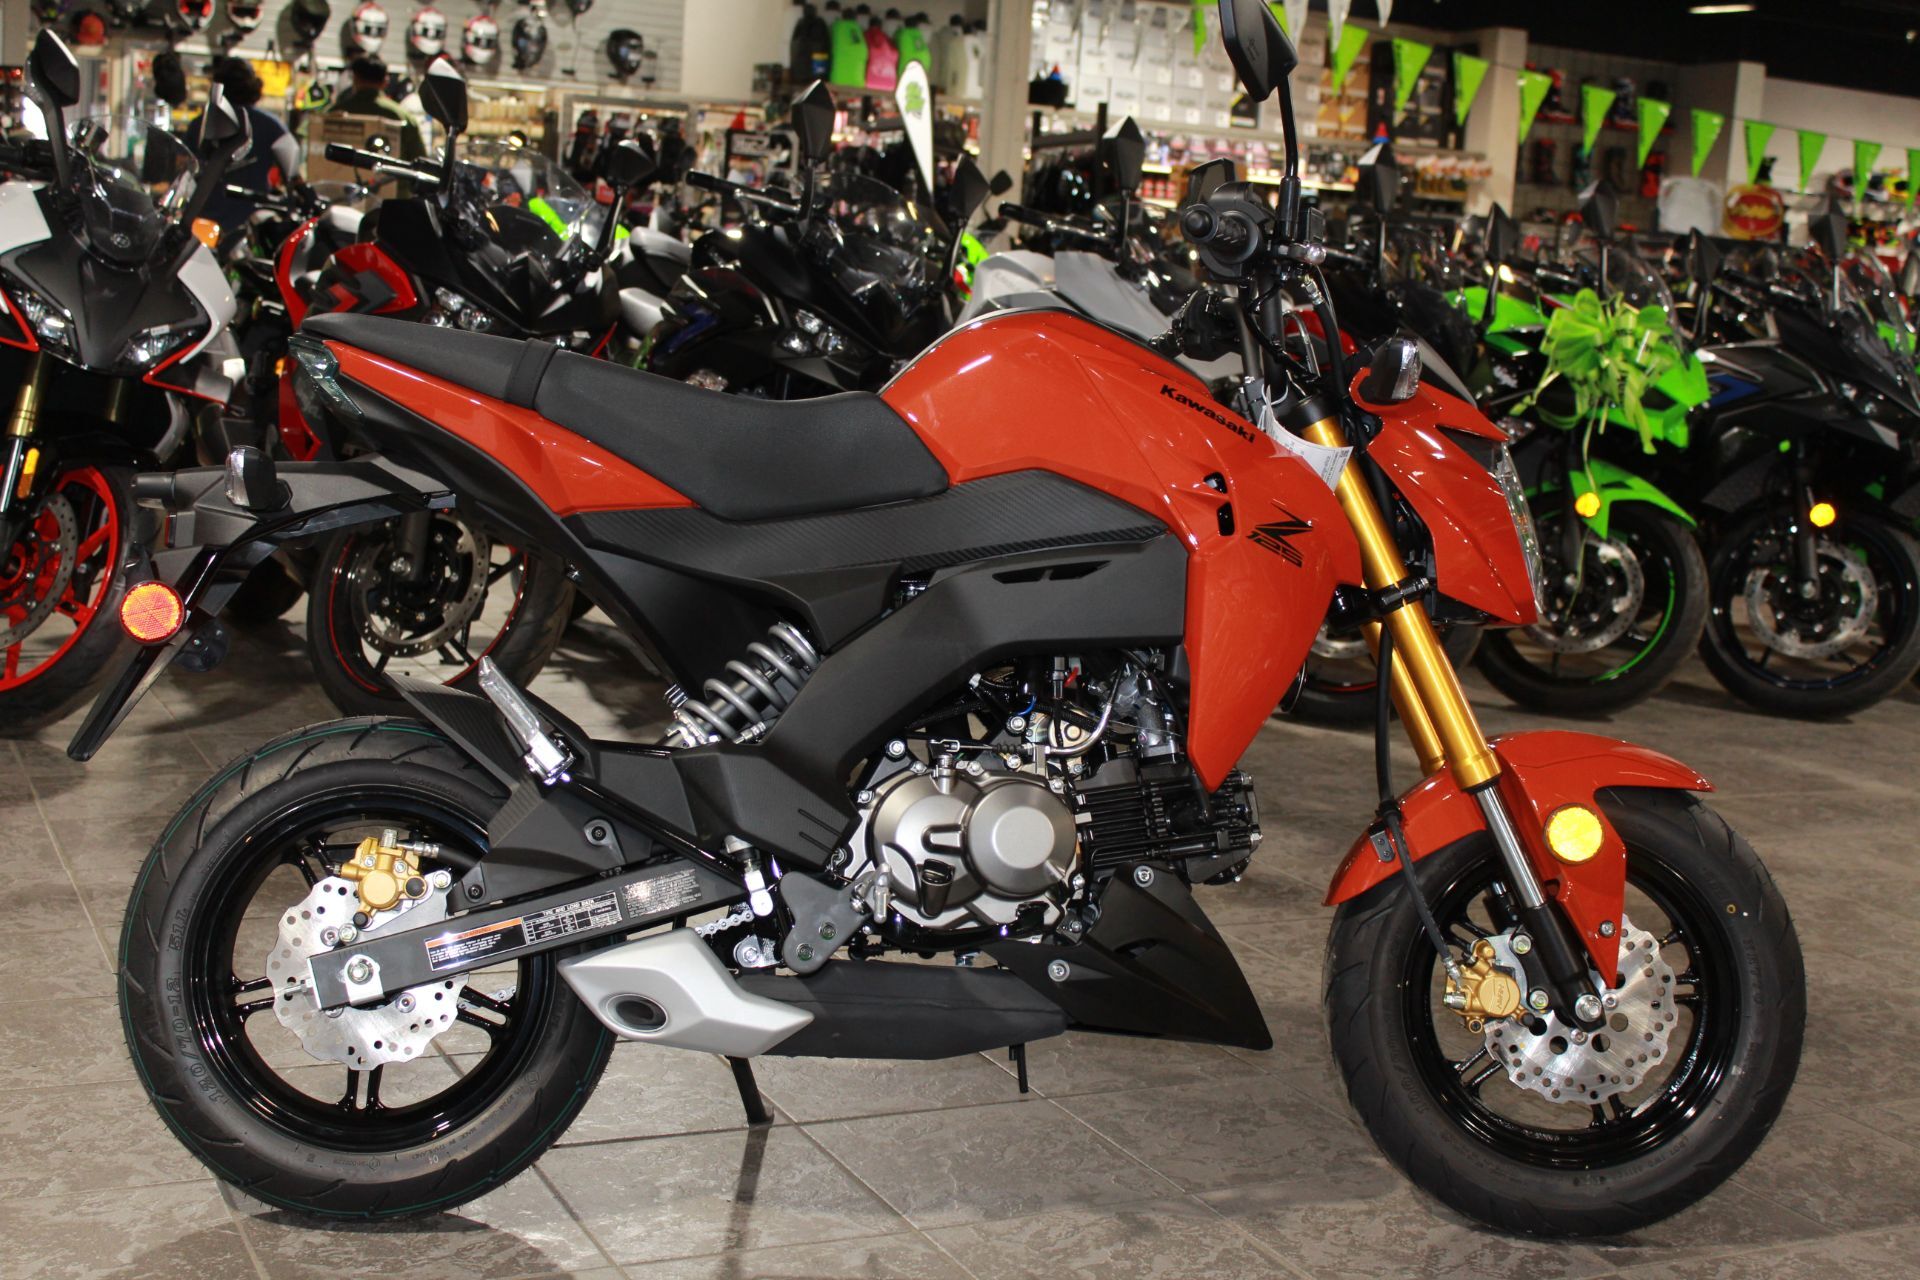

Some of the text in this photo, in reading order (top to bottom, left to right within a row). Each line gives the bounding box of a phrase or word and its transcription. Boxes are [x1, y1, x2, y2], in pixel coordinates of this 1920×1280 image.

[1160, 384, 1255, 443] Kawasaki
[1246, 530, 1303, 568] 125
[166, 976, 226, 1104] 120/70-12
